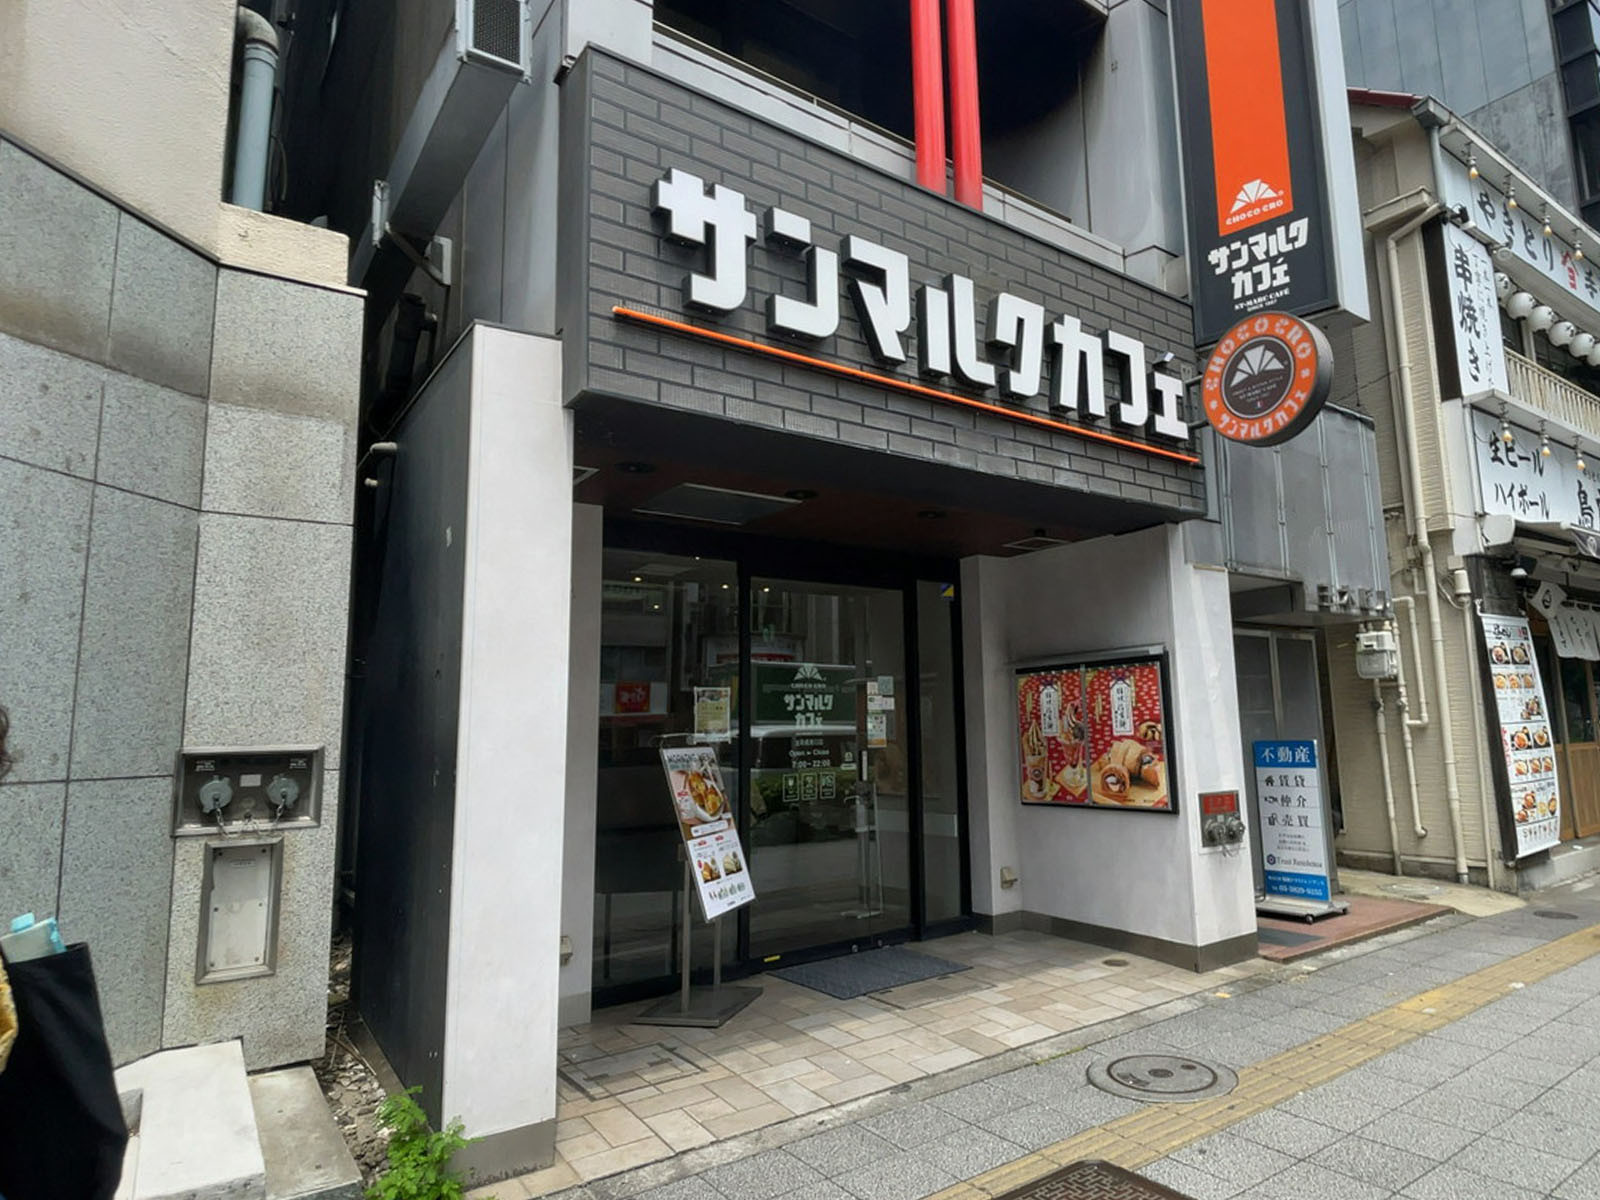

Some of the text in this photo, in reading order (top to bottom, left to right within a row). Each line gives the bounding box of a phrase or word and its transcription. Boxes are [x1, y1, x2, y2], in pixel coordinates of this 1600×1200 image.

[1226, 199, 1284, 225] CHOCO CRO
[1477, 190, 1554, 272] やきとり
[1207, 217, 1309, 275] サンマルク
[1231, 257, 1291, 300] カフェ
[652, 168, 1190, 442] サンマルクカフェ
[1454, 244, 1481, 383] 串焼き
[1218, 390, 1308, 441] サンマルクカフェ
[1489, 430, 1545, 477] 生ビール
[1494, 482, 1549, 520] ハイボール
[784, 694, 834, 711] サンマルク
[795, 712, 823, 729] カフェ
[1261, 746, 1311, 763] 不動産
[1278, 775, 1306, 787] 賃貸
[1280, 795, 1307, 807] 仲介
[1281, 814, 1310, 827] 売買
